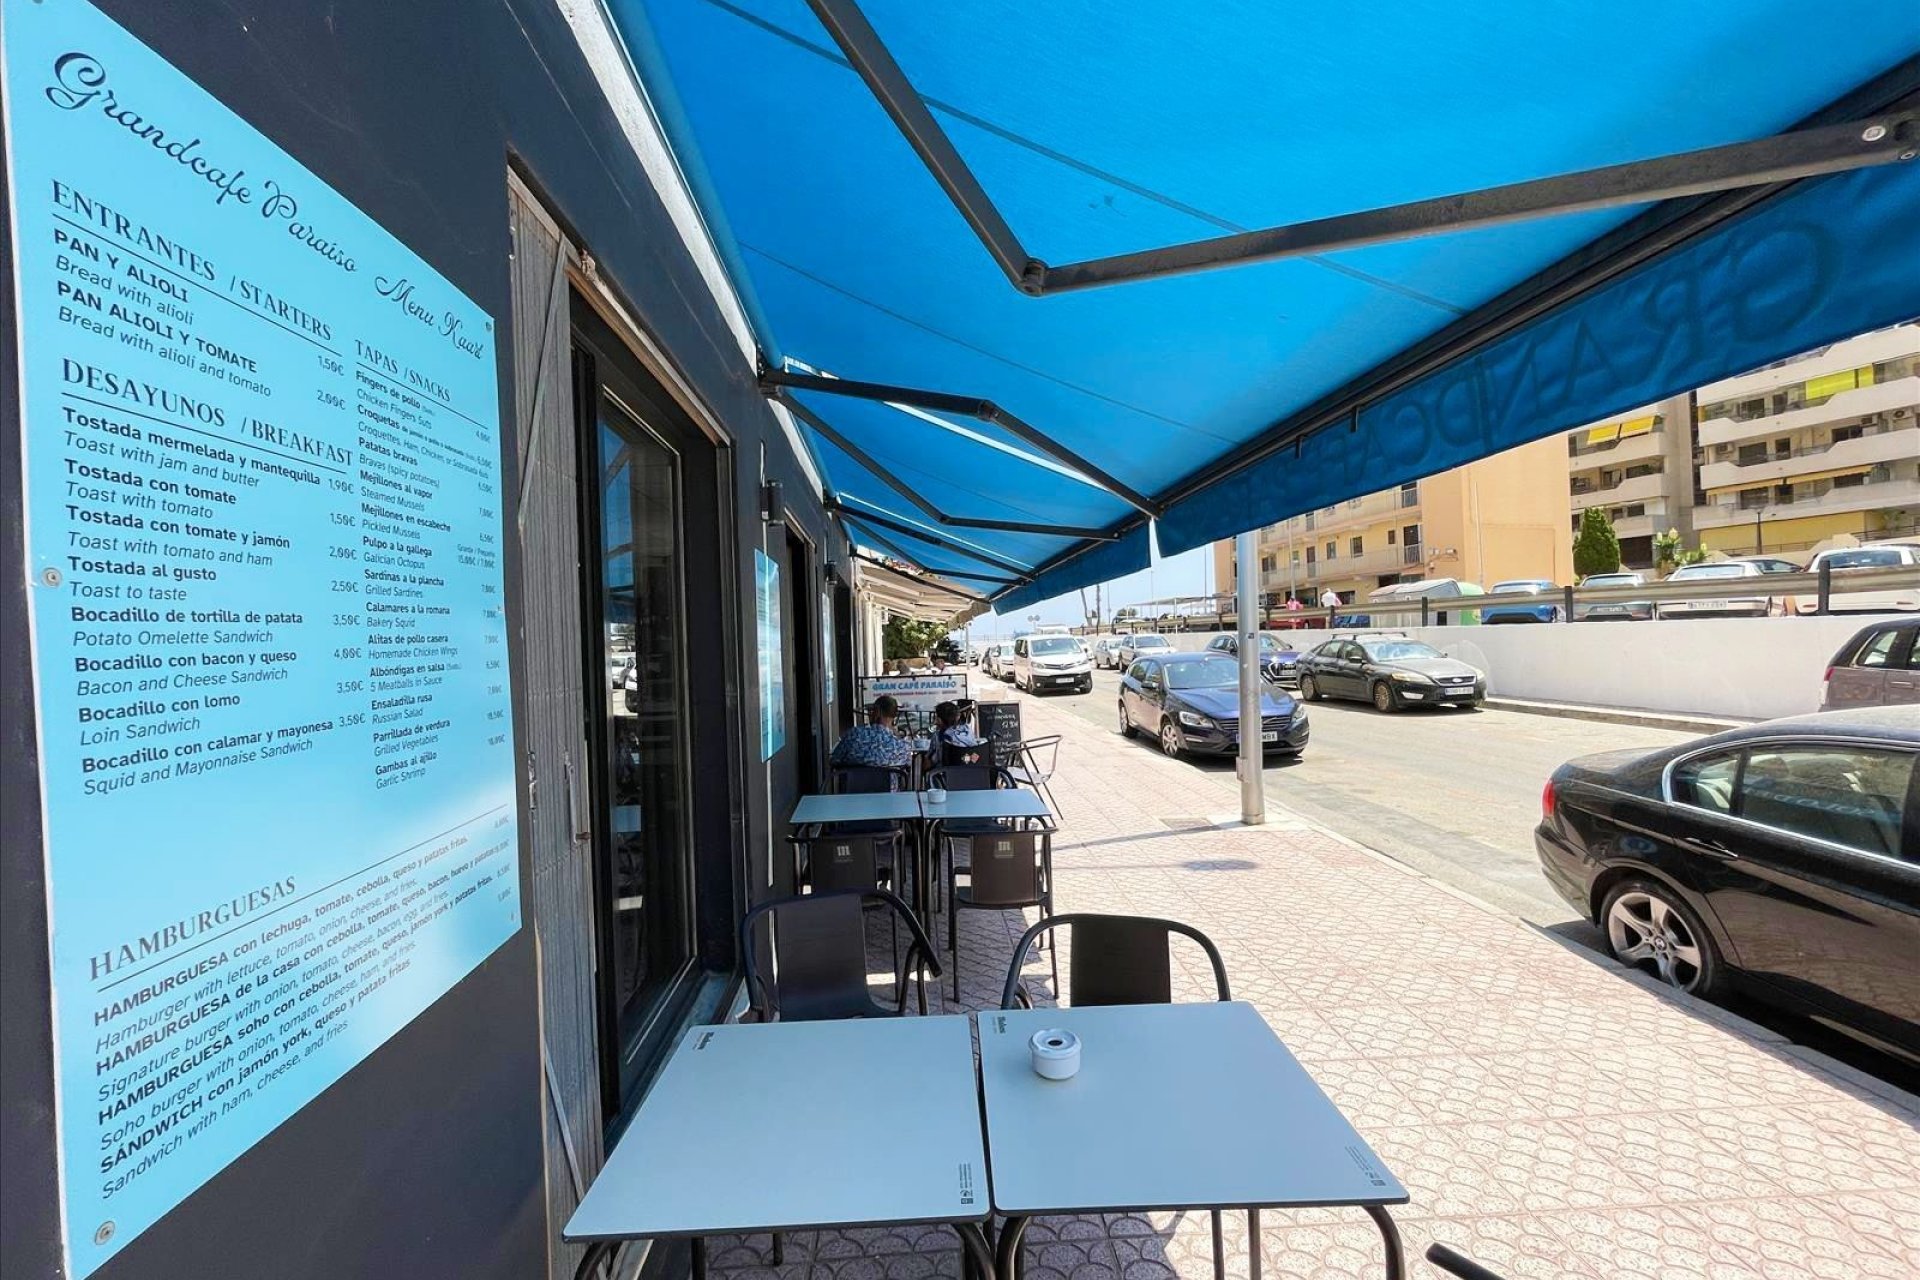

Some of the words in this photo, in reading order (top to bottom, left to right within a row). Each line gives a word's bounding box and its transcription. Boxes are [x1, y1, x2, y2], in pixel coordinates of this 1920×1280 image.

[46, 52, 252, 204] Grandcafe
[374, 275, 434, 326] Menu
[53, 180, 215, 281] ENTRANTES
[54, 228, 99, 262] PAN
[106, 252, 119, 270] Y
[126, 263, 188, 303] ALIOLI
[55, 254, 112, 290] Bread
[117, 283, 151, 308] with
[156, 301, 194, 326] alioli
[57, 280, 102, 312] PAN
[108, 303, 173, 340] ALIOLI
[178, 329, 190, 346] Y
[194, 337, 257, 373] TOMATE
[58, 305, 114, 338] Bread
[120, 332, 154, 353] with
[158, 346, 196, 369] alioli
[198, 362, 225, 379] and
[228, 371, 271, 397] tomato
[354, 339, 398, 374] TAPAS
[63, 358, 225, 427] DESAYUNOS
[355, 370, 388, 394] Fingers
[356, 403, 400, 429] Croquetas
[62, 406, 141, 440] Tostada
[148, 432, 234, 463] mermelada
[239, 455, 247, 469] y
[250, 459, 320, 485] mantequilla
[64, 430, 115, 456] Toast
[120, 446, 154, 464] with
[157, 452, 187, 472] jam
[191, 464, 218, 479] and
[221, 467, 260, 487] butter
[358, 436, 391, 457] Patatas
[392, 448, 418, 466] bravas
[64, 458, 143, 487] Tostada
[149, 478, 179, 494] con
[184, 483, 236, 504] tomate
[65, 480, 116, 503] Toast
[122, 492, 156, 510] with
[161, 498, 213, 519] tomato
[359, 469, 402, 491] Mejillones
[413, 487, 432, 499] vapor
[65, 504, 143, 529] Tostada
[149, 520, 179, 534] con
[185, 522, 237, 541] tomate
[240, 532, 249, 545] y
[251, 530, 290, 549] jamón
[361, 502, 404, 521] Mejillones
[68, 531, 119, 551] Toast
[123, 538, 157, 555] with
[163, 543, 215, 561] tomato
[218, 551, 243, 563] and
[246, 551, 272, 566] ham
[362, 535, 388, 550] Pulpo
[405, 544, 432, 558] gallega
[67, 555, 146, 576] Tostada
[151, 563, 168, 577] al
[173, 567, 216, 582] gusto
[364, 568, 401, 582] Sardinas
[69, 580, 121, 598] Toast
[126, 585, 143, 599] to
[148, 586, 187, 601] taste
[365, 601, 409, 613] Calamares
[71, 606, 159, 622] Bocadillo
[165, 608, 186, 622] de
[190, 608, 240, 623] tortilla
[244, 610, 261, 623] de
[264, 612, 303, 626] patata
[73, 630, 132, 646] Potato
[137, 630, 209, 645] Omelette
[213, 629, 273, 644] Sandwich
[367, 633, 393, 644] Alitas
[406, 634, 425, 645] pollo
[426, 635, 448, 643] casera
[75, 654, 162, 672] Bocadillo
[167, 655, 196, 667] con
[201, 652, 244, 665] bacon
[248, 653, 256, 665] y
[259, 651, 297, 664] queso
[369, 665, 415, 677] Albóndigas
[426, 662, 445, 672] salsa
[77, 679, 133, 696] Bacon
[137, 674, 168, 691] and
[173, 673, 227, 688] Cheese
[230, 667, 288, 684] Sandwich
[78, 700, 166, 723] Bocadillo
[170, 699, 199, 712] con
[203, 694, 240, 708] lomo
[371, 694, 415, 710] Ensaladilla
[80, 727, 120, 746] Loin
[125, 716, 200, 739] Sandwich
[82, 747, 169, 773] Bocadillo
[174, 742, 202, 757] con
[207, 732, 262, 751] calamar
[265, 730, 273, 743] y
[277, 720, 333, 739] mayonesa
[372, 726, 412, 743] Parrillada
[84, 771, 135, 795] Squid
[140, 764, 171, 783] and
[174, 750, 257, 776] Mayonnaise
[260, 738, 313, 759] Sandwich
[374, 759, 408, 775] Gambas
[90, 875, 295, 981] HAMBURGUESAS
[94, 951, 228, 1026] HAMBURGUESA
[232, 938, 257, 958] con
[260, 914, 312, 944] lechuga,
[314, 893, 354, 918] tomate,
[95, 994, 191, 1054] Hamburger
[194, 977, 223, 1001] with
[226, 954, 272, 985] lettuce,
[96, 992, 231, 1076] HAMBURGUESA
[234, 982, 252, 999] de
[256, 973, 269, 987] la
[272, 956, 300, 978] casa
[303, 943, 323, 961] con
[98, 1046, 180, 1102] Signature
[184, 1015, 232, 1052] burger
[234, 999, 261, 1022] with
[99, 1034, 233, 1125] HAMBURGUESA
[237, 1013, 270, 1040] soho
[273, 997, 295, 1017] con
[298, 971, 341, 1002] cebolla,
[100, 1094, 203, 1173] SÁNDWICH
[207, 1077, 234, 1101] con
[237, 1047, 279, 1085] jamón
[282, 1027, 312, 1054] york,
[314, 1002, 347, 1029] queso
[100, 1114, 145, 1150] Soho
[150, 1076, 202, 1119] burger
[206, 1055, 234, 1082] with
[237, 1032, 275, 1062] onion,
[102, 1134, 182, 1199] Sandwich
[187, 1110, 217, 1139] with
[256, 1054, 301, 1090] cheese,
[304, 1033, 324, 1057] and
[326, 1019, 348, 1042] fries
